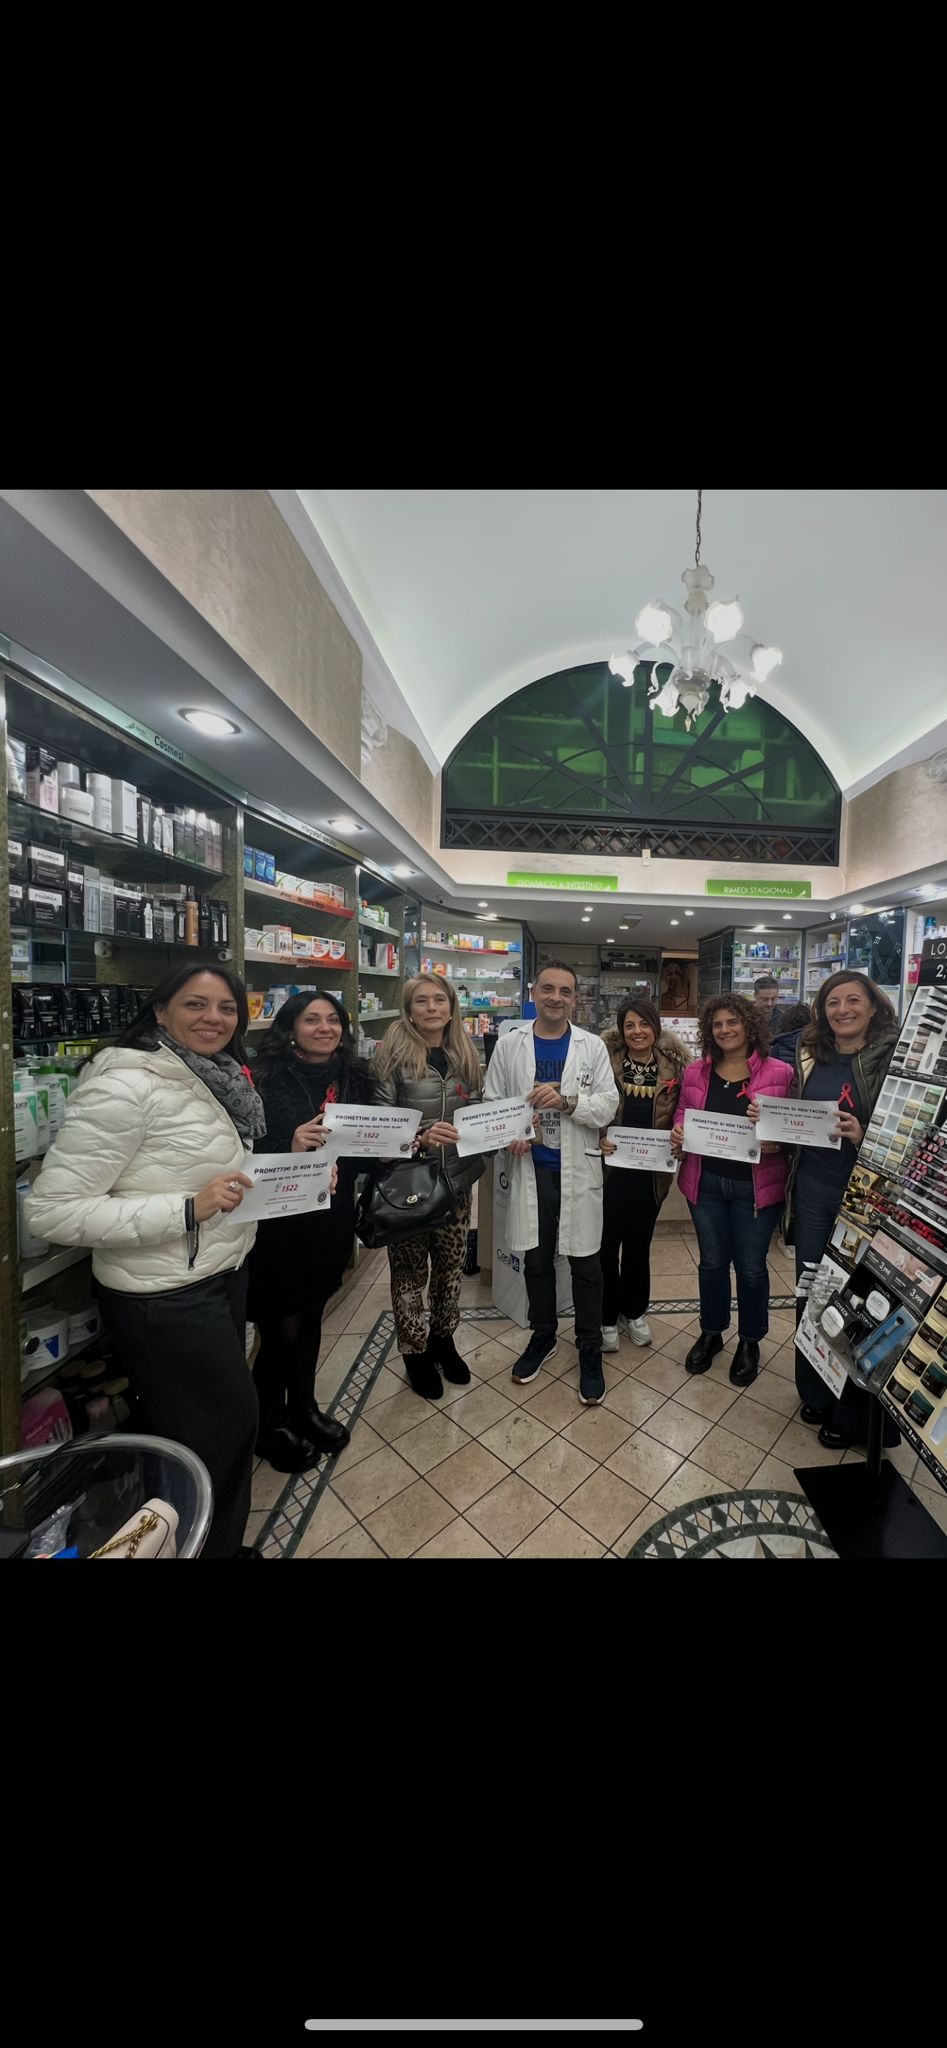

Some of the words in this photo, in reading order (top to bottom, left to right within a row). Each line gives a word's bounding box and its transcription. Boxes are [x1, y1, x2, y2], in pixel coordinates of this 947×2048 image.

[154, 735, 184, 760] Cosmesi
[37, 852, 59, 861] FILORGA
[567, 881, 603, 889] INTESTINO
[723, 886, 748, 894] RIMEDI
[750, 886, 793, 895] STAGIONALI
[35, 893, 57, 901] FILORGA
[936, 964, 946, 979] 2,
[462, 1112, 492, 1121] PROMETTIMI
[692, 1118, 718, 1126] PROMETTIMI
[282, 1184, 299, 1192] 1522
[834, 1300, 849, 1317] LOVREN
